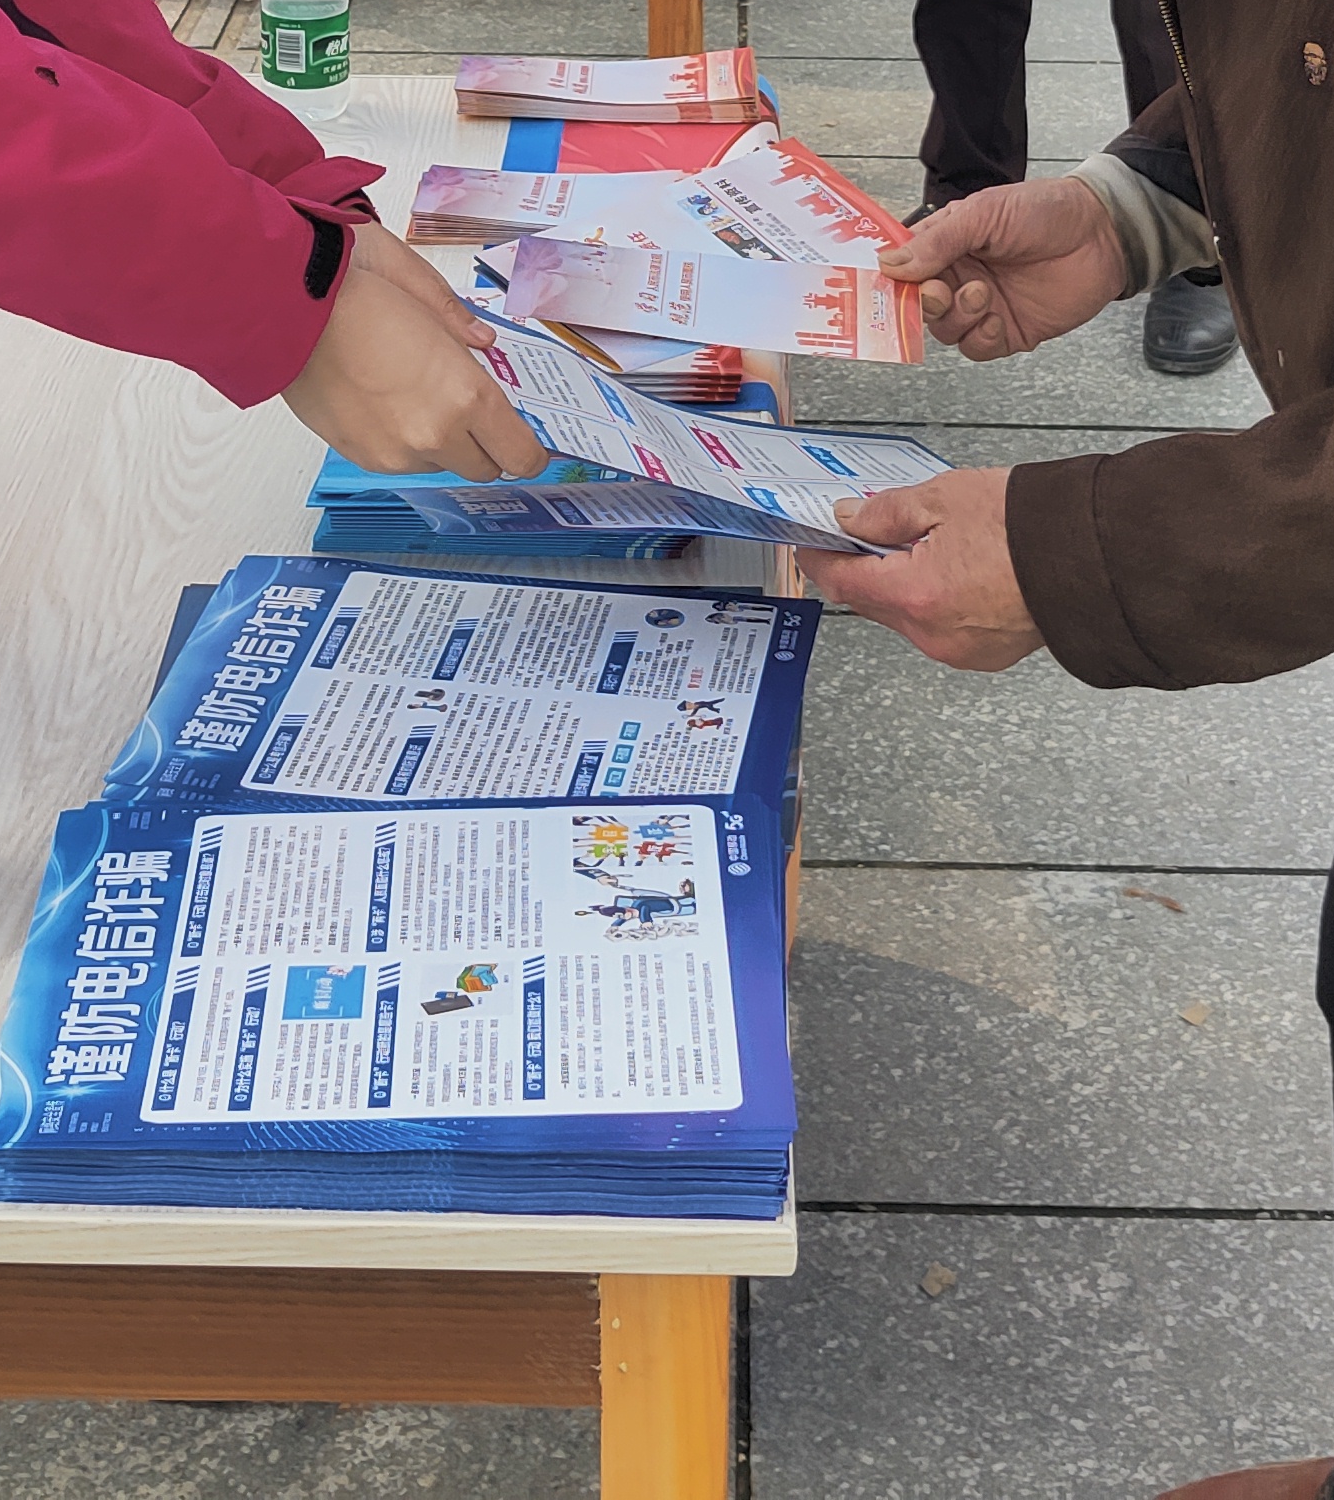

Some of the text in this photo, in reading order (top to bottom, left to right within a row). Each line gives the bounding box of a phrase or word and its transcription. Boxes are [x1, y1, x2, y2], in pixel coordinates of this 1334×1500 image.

[177, 583, 326, 753] 谨防电信诈骗
[722, 812, 746, 830] 5G
[45, 847, 175, 1089] 谨防电信诈骗
